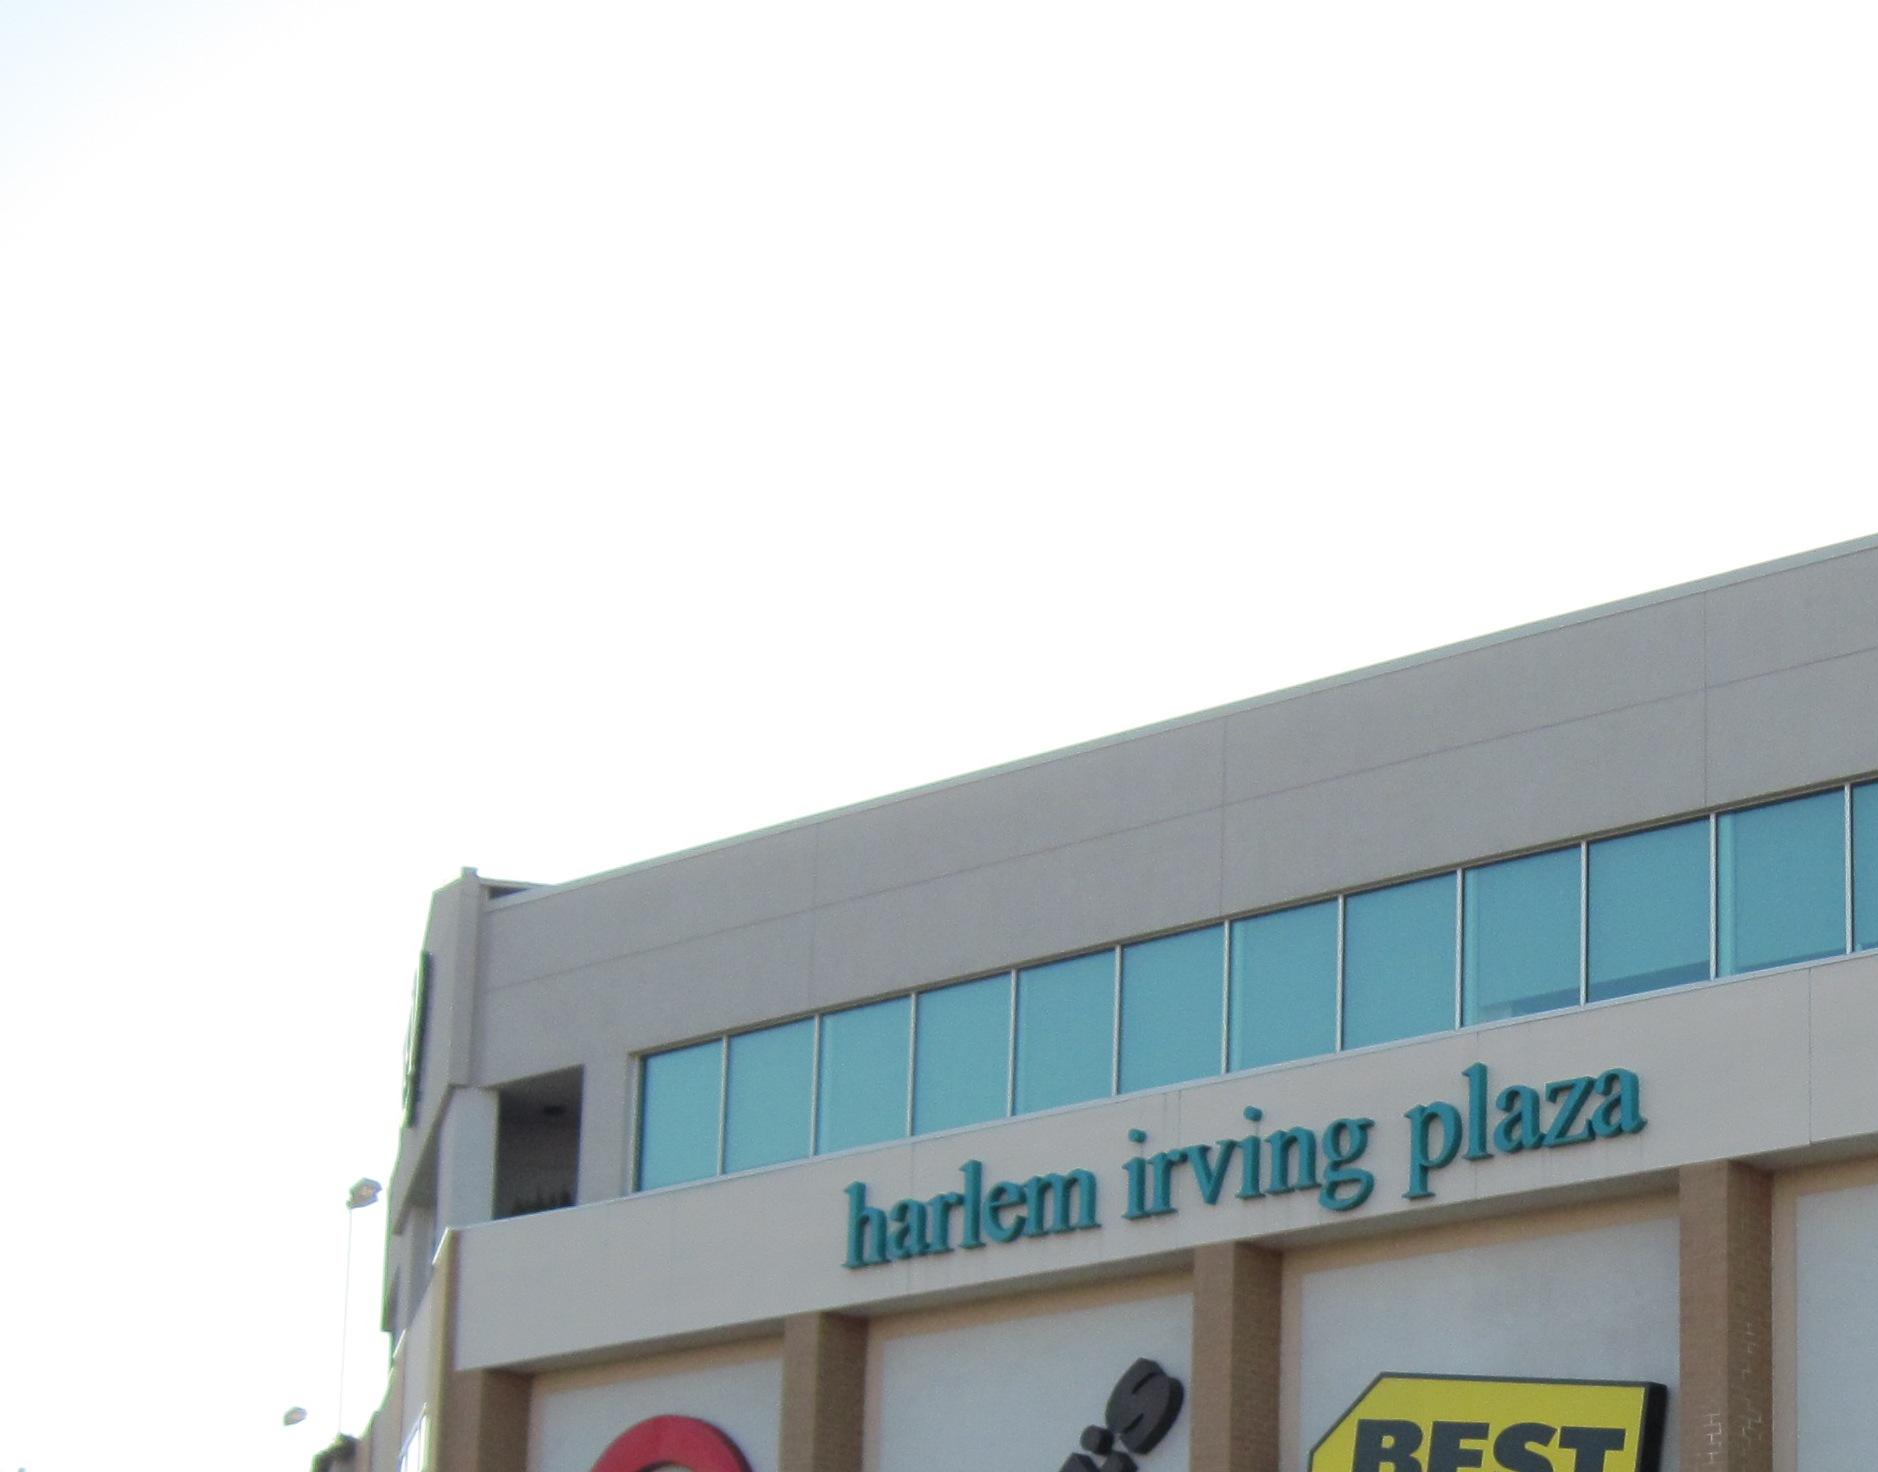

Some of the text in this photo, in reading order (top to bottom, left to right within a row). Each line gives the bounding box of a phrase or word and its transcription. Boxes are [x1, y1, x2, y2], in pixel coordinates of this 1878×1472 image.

[842, 1062, 1647, 1272] harlem irving plaza
